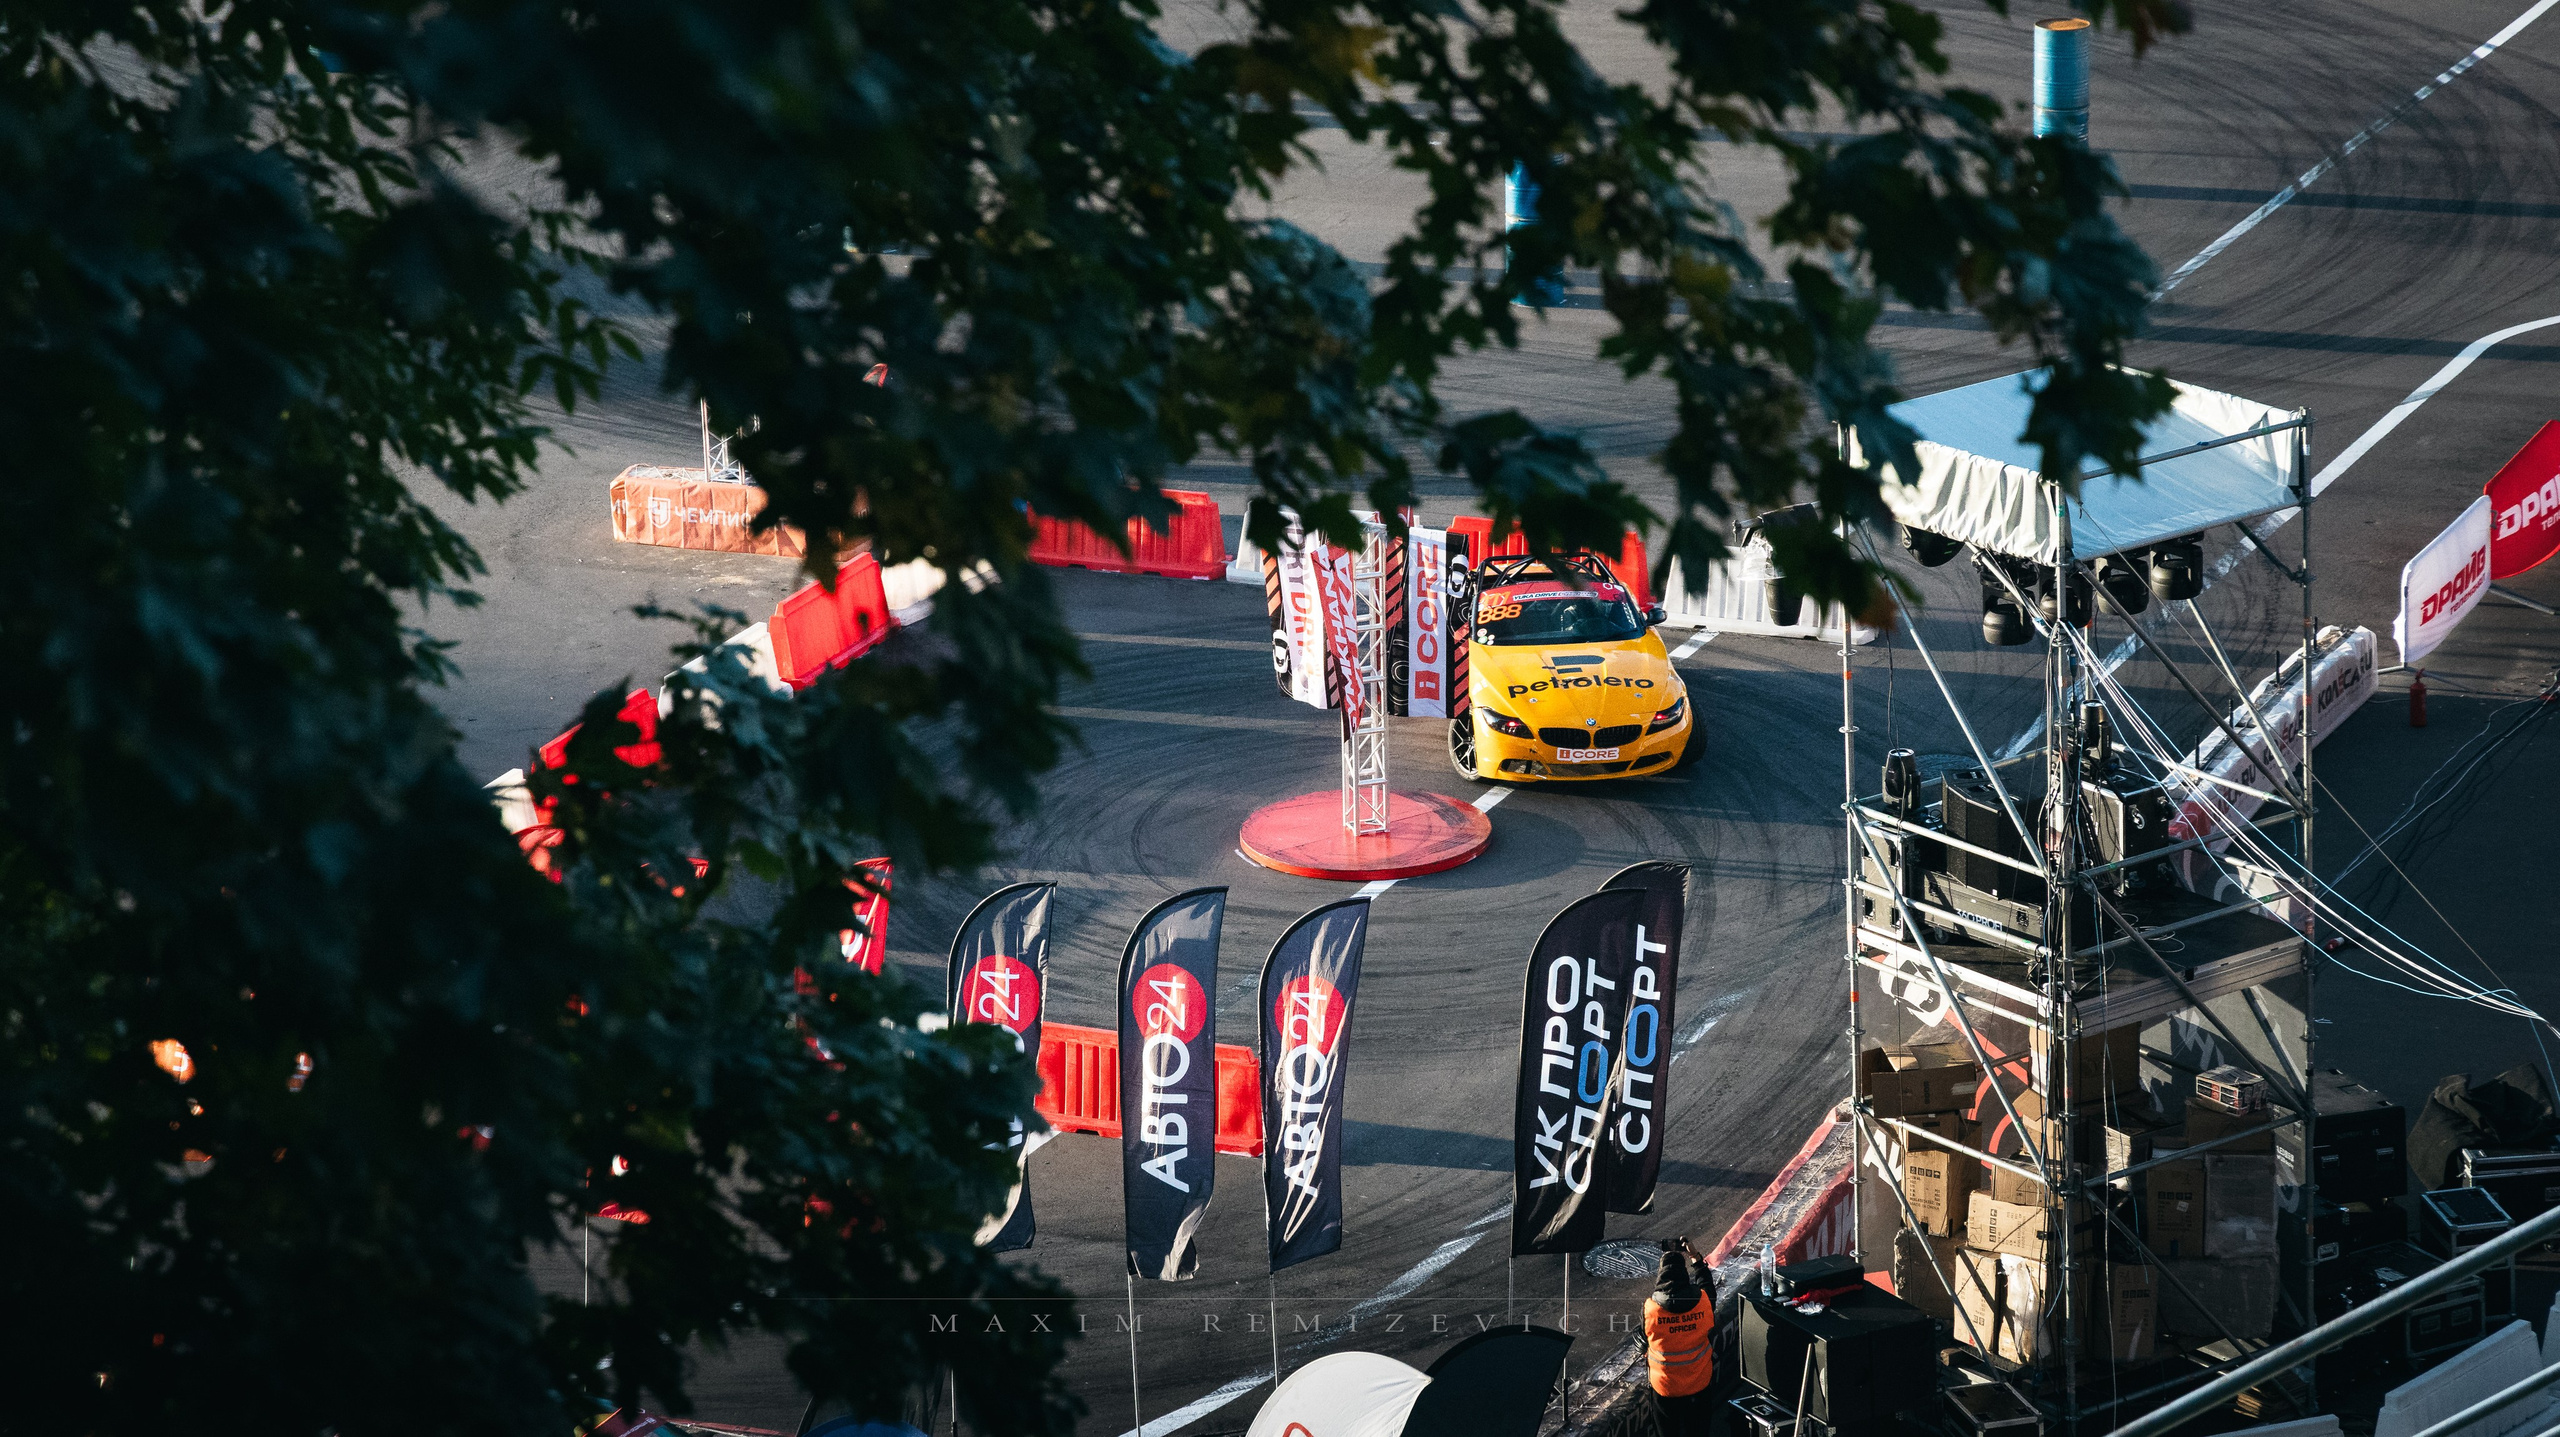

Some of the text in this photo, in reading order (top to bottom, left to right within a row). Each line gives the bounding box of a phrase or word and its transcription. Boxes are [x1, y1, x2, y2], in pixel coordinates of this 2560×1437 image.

[674, 506, 756, 528] ЧЕМПИО
[1416, 541, 1438, 664] CORE
[1477, 604, 1522, 625] 888
[1507, 675, 1654, 698] petrolero
[1573, 749, 1618, 759] CORE
[1540, 955, 1581, 1100] ПРО
[1619, 924, 1667, 1154] СПОРТ
[1564, 958, 1615, 1195] СПОРТ
[1657, 1311, 1705, 1325] STAGE SAFETY
[1669, 1323, 1697, 1334] OFFICER
